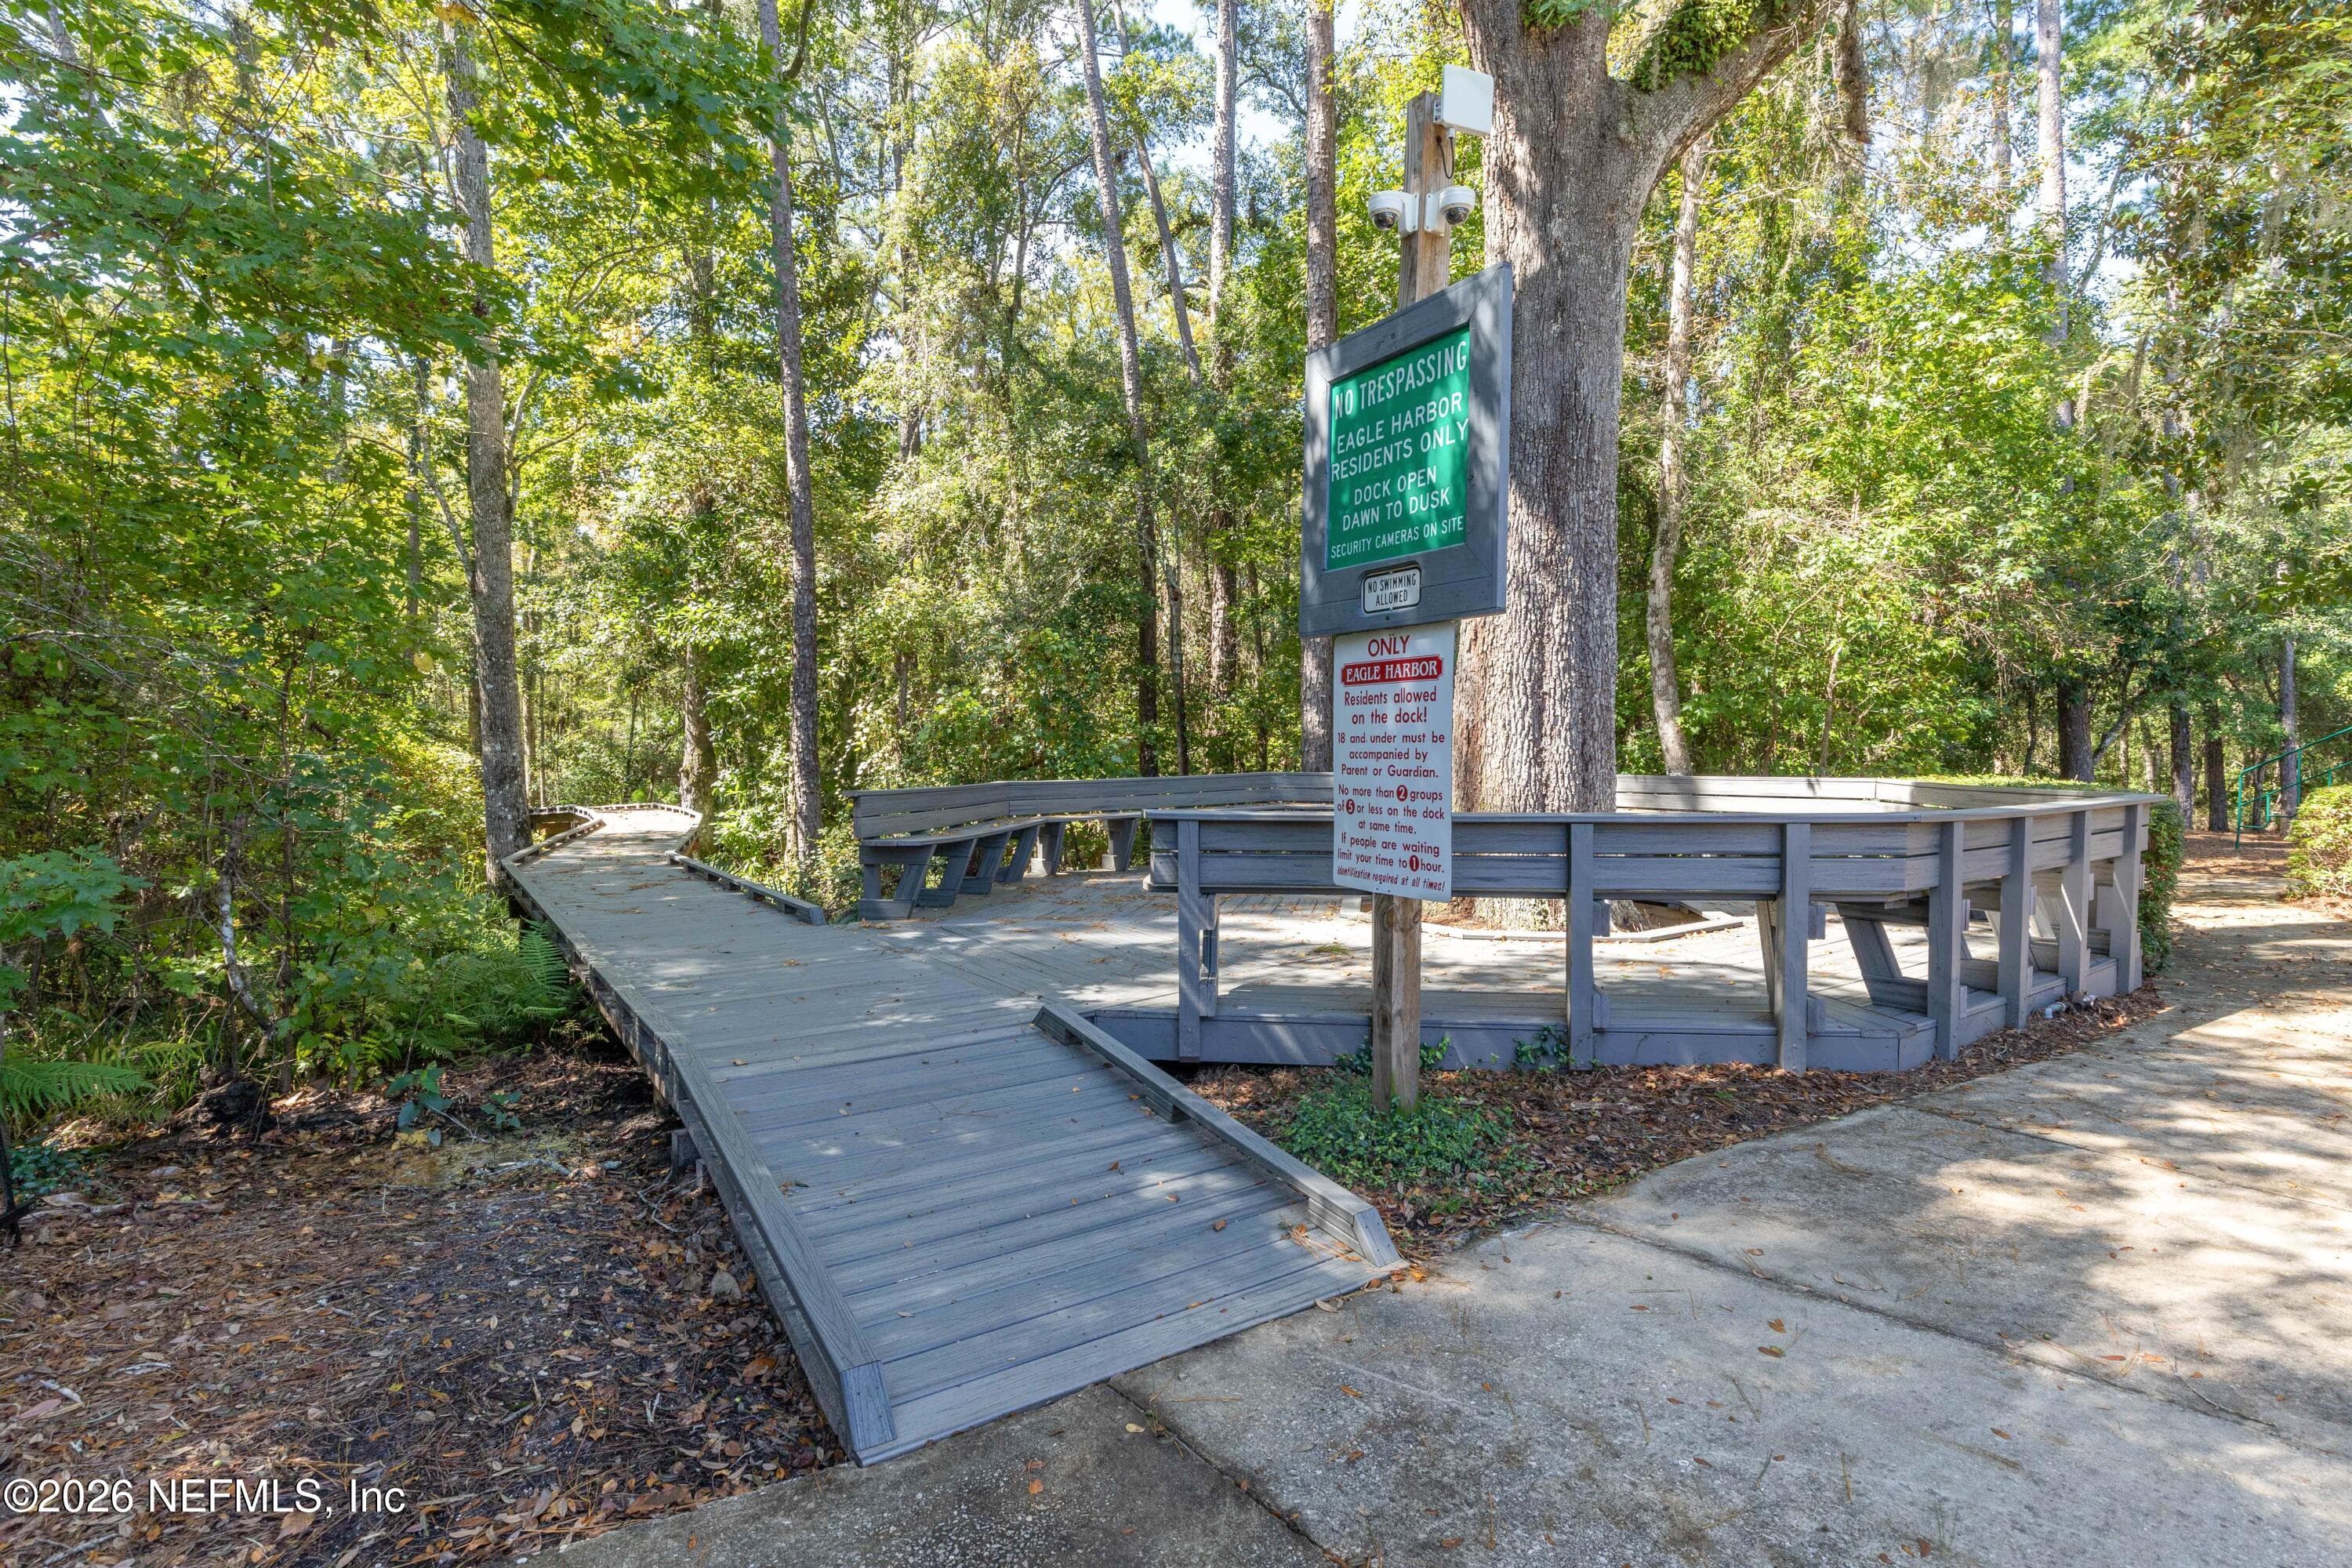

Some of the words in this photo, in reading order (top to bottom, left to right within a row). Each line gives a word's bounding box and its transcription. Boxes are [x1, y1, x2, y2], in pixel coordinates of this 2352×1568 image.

[1335, 389, 1352, 420] NO
[1360, 340, 1467, 409] TRESPASSING
[1338, 420, 1384, 454] EAGLE
[1392, 392, 1462, 435] HARBOR
[1331, 438, 1412, 482] RESIDENTS
[1421, 418, 1468, 452] ONLY
[1355, 479, 1391, 506] DOCK
[1398, 465, 1436, 492] OPEN
[1343, 506, 1379, 531] DAWN
[1386, 501, 1402, 520] TO
[1410, 487, 1450, 514] DUSK
[1331, 538, 1371, 558] SECURITY
[1375, 527, 1419, 549] CAMERAS
[1424, 522, 1437, 538] ON
[1442, 516, 1464, 534] SITE
[1368, 581, 1377, 593] NO
[1380, 573, 1416, 591] SWIMMING
[1376, 590, 1407, 606] ALLOWED
[1368, 635, 1410, 657] ONLY
[1346, 666, 1380, 682] EAGLE
[1385, 660, 1438, 679] HARBOR
[1345, 691, 1387, 706] Residents
[1394, 686, 1436, 702] allowed
[1352, 713, 1364, 724] on
[1371, 709, 1388, 724] the
[1395, 706, 1427, 723] dock!
[1338, 733, 1345, 743] 18
[1350, 732, 1365, 743] and
[1370, 731, 1396, 743] under
[1403, 733, 1425, 742] must
[1432, 731, 1445, 742] be
[1349, 749, 1409, 761] accompanied
[1415, 748, 1428, 762] by
[1342, 764, 1367, 775] Parent
[1388, 765, 1438, 778] Guardian.
[1339, 784, 1348, 795] No
[1353, 788, 1371, 797] more
[1377, 786, 1394, 798] than
[1399, 788, 1405, 798] 2
[1410, 790, 1443, 803] groups
[1338, 800, 1344, 811] of
[1348, 801, 1353, 811] 5
[1369, 803, 1382, 815] less
[1388, 808, 1398, 816] on
[1403, 806, 1417, 817] the
[1423, 807, 1444, 819] dock
[1359, 820, 1365, 829] at
[1370, 822, 1389, 832] same
[1395, 822, 1417, 834] time.
[1341, 832, 1346, 843] If
[1350, 836, 1376, 848] people
[1381, 841, 1396, 850] are
[1403, 841, 1439, 857] waiting
[1338, 848, 1352, 860] limit
[1356, 853, 1371, 863] your
[1376, 854, 1393, 866] time
[1399, 858, 1407, 868] to
[1421, 859, 1444, 873] hour.
[1373, 873, 1398, 884] required
[1402, 876, 1408, 886] at
[1412, 877, 1421, 887] all
[1424, 879, 1445, 891] times!
